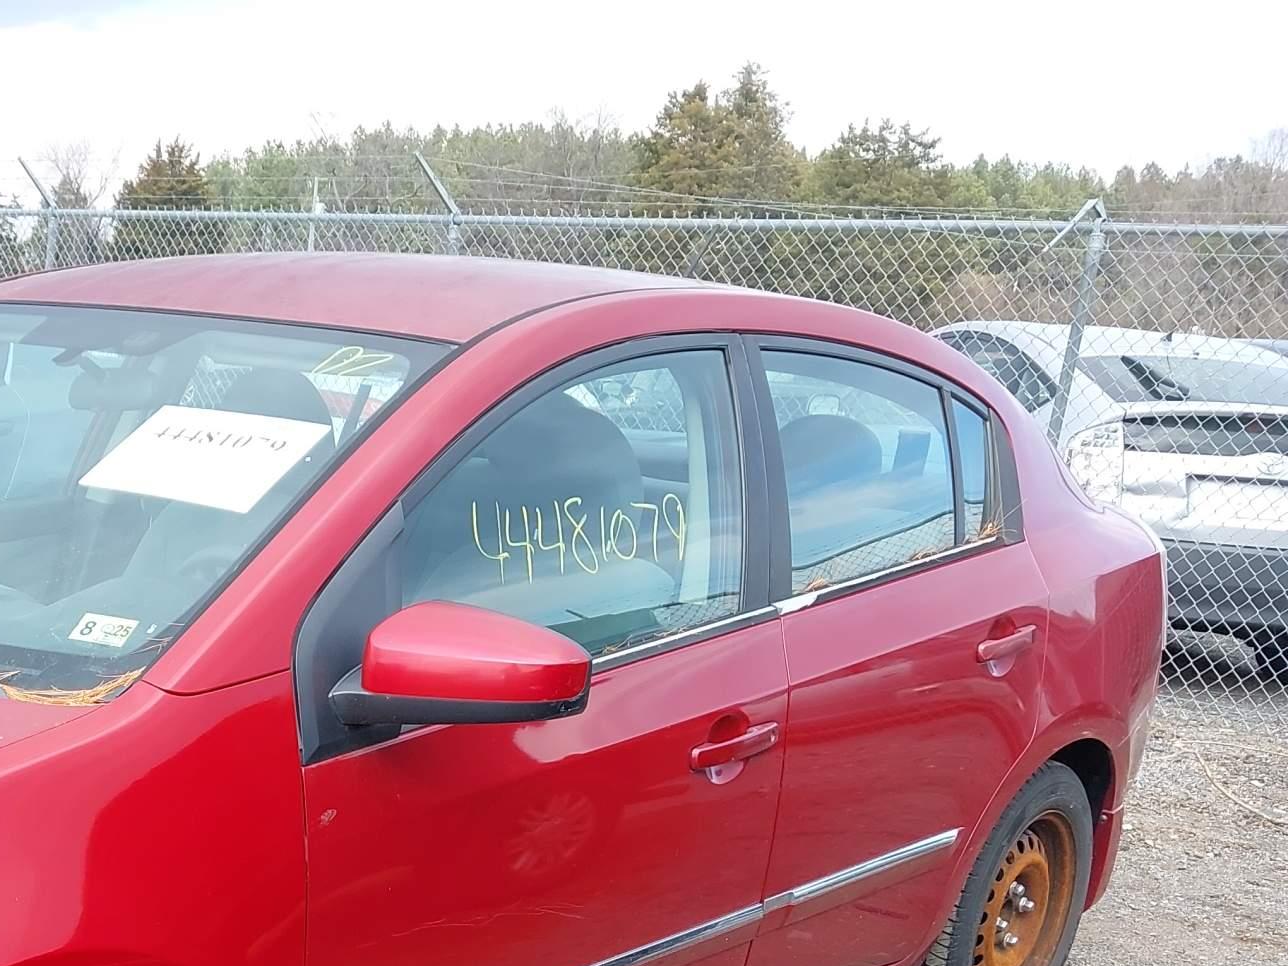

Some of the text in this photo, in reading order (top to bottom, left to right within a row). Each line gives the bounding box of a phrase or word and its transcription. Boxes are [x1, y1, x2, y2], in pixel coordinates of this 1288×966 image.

[472, 493, 687, 585] 44481079
[79, 620, 133, 638] 8 25
